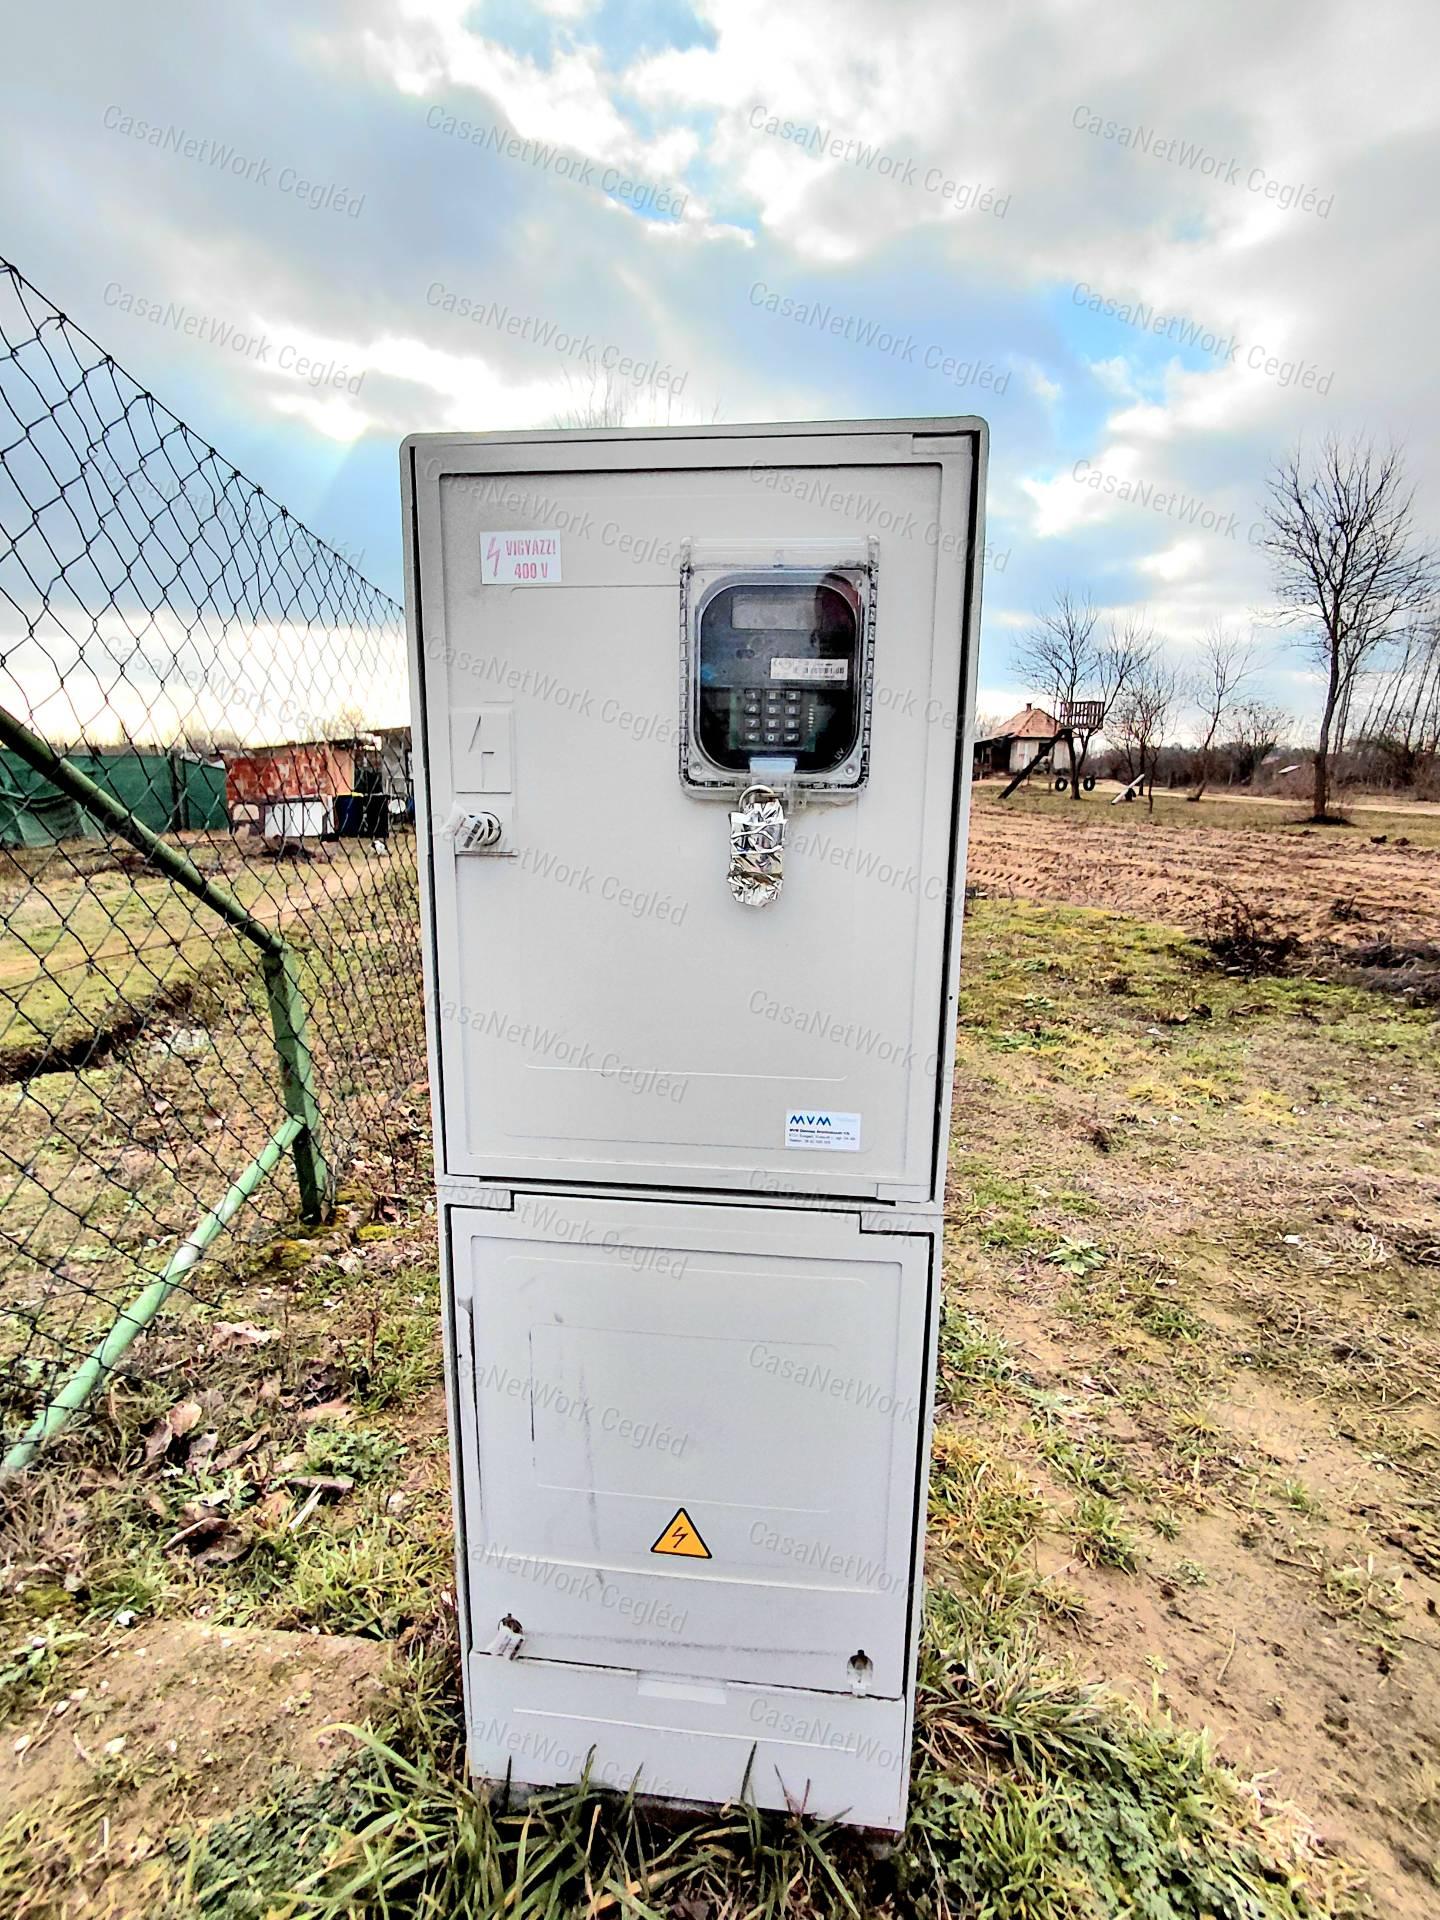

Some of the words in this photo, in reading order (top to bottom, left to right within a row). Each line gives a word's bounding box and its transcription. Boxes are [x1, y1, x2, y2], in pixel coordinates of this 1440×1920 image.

[514, 562, 537, 579] 400
[541, 562, 548, 578] V
[789, 1114, 832, 1126] MVM
